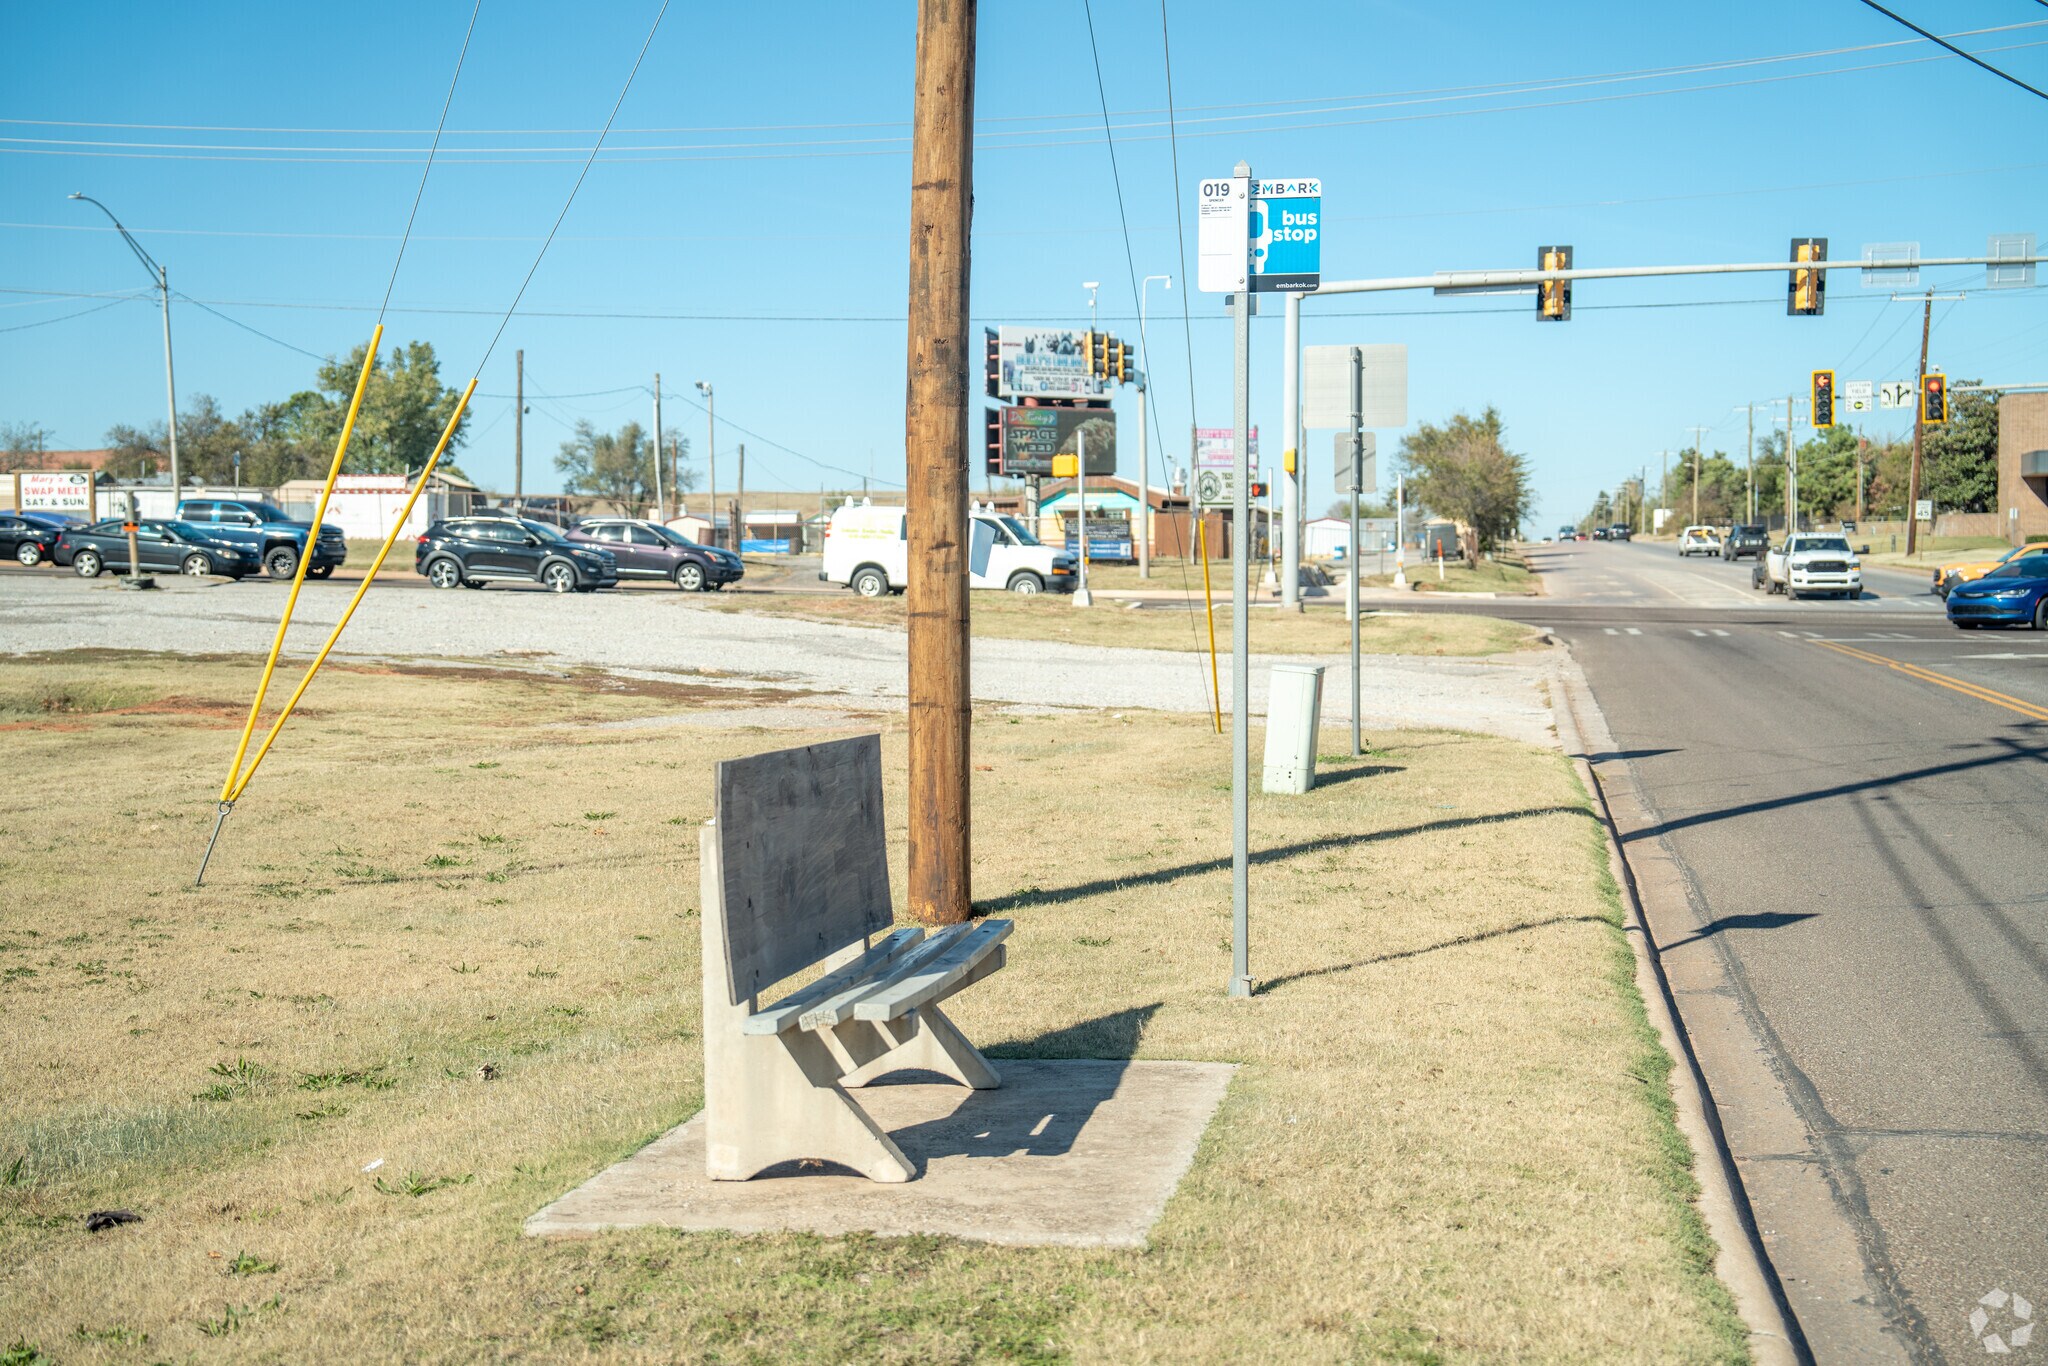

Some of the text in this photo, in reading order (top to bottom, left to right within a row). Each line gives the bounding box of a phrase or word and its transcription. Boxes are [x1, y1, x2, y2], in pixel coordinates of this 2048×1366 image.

[1203, 183, 1230, 197] 019
[1282, 210, 1317, 226] bus
[1274, 227, 1317, 244] stop
[1009, 428, 1057, 440] SPACE
[1014, 442, 1054, 453] WEED
[24, 486, 88, 496] SWAP MEET
[62, 498, 88, 506] SUN.
